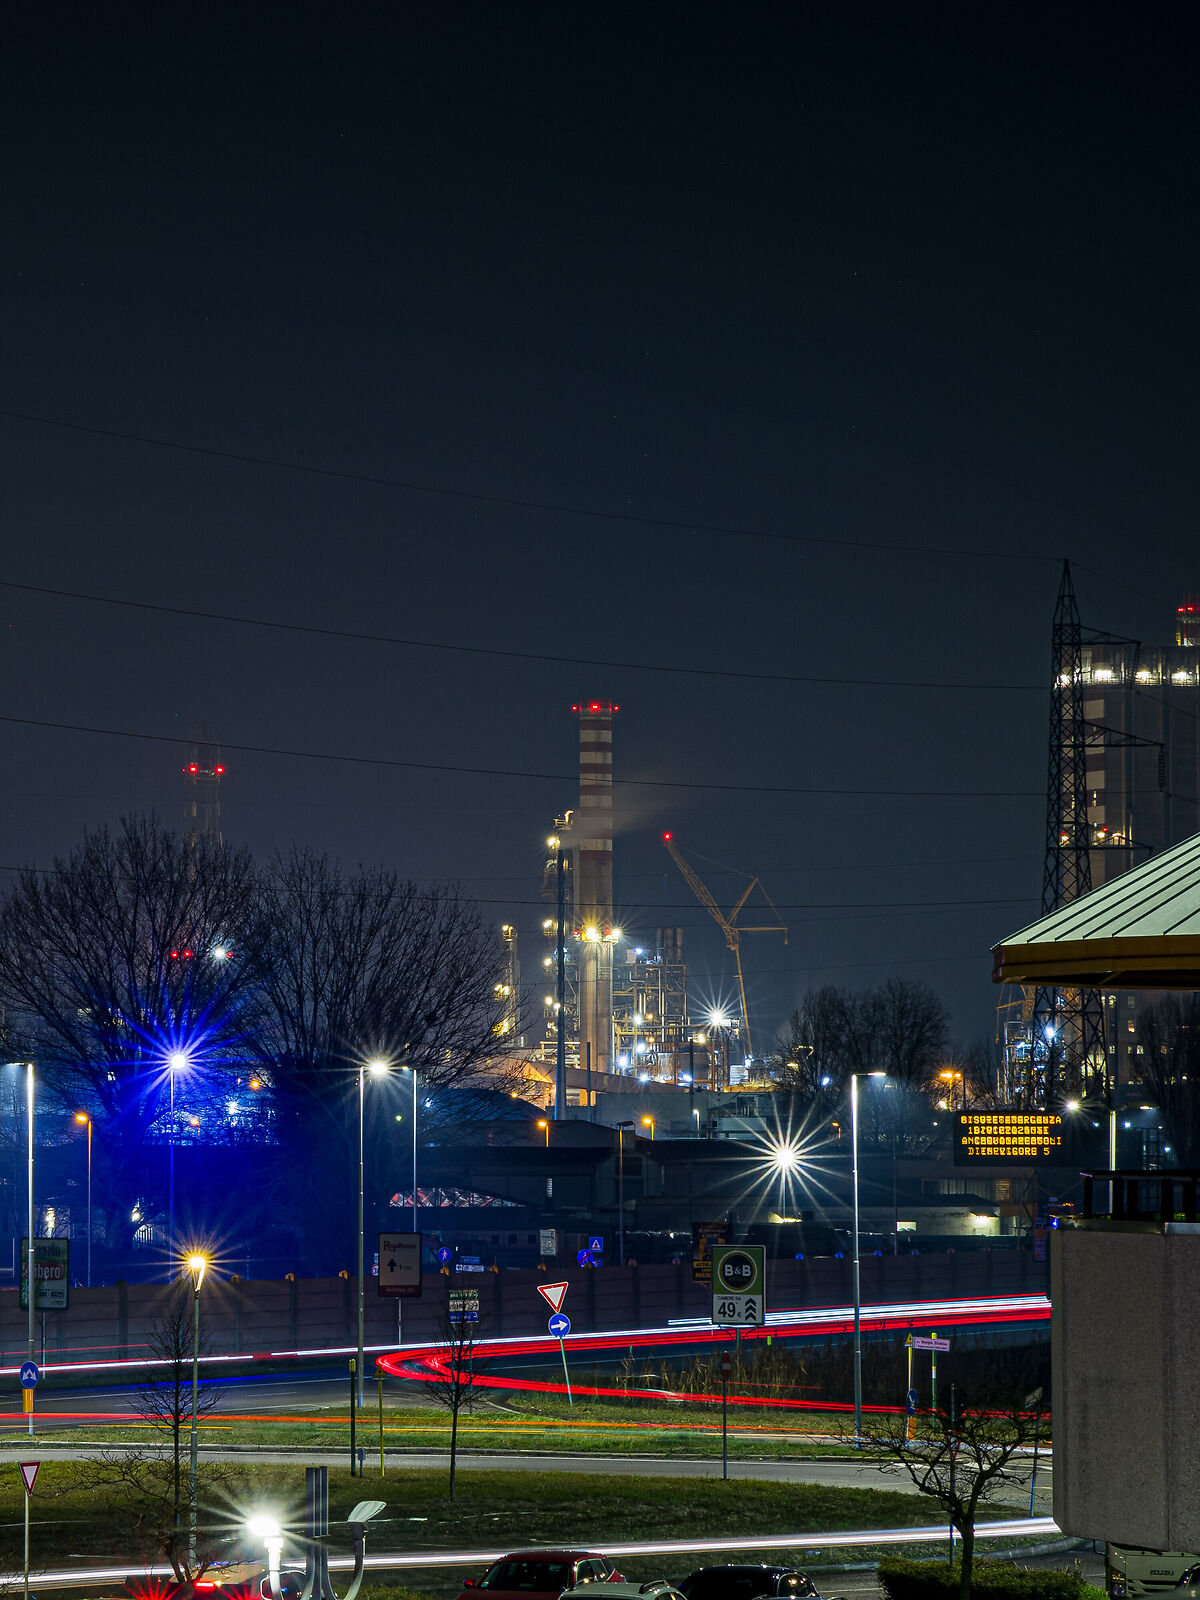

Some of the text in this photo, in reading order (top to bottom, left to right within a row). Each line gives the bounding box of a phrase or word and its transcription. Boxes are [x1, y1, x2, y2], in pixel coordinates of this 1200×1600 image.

[32, 1262, 61, 1279] ibero
[724, 1264, 752, 1277] B&B
[717, 1302, 736, 1318] 49
[1150, 1569, 1175, 1577] ISUZU
